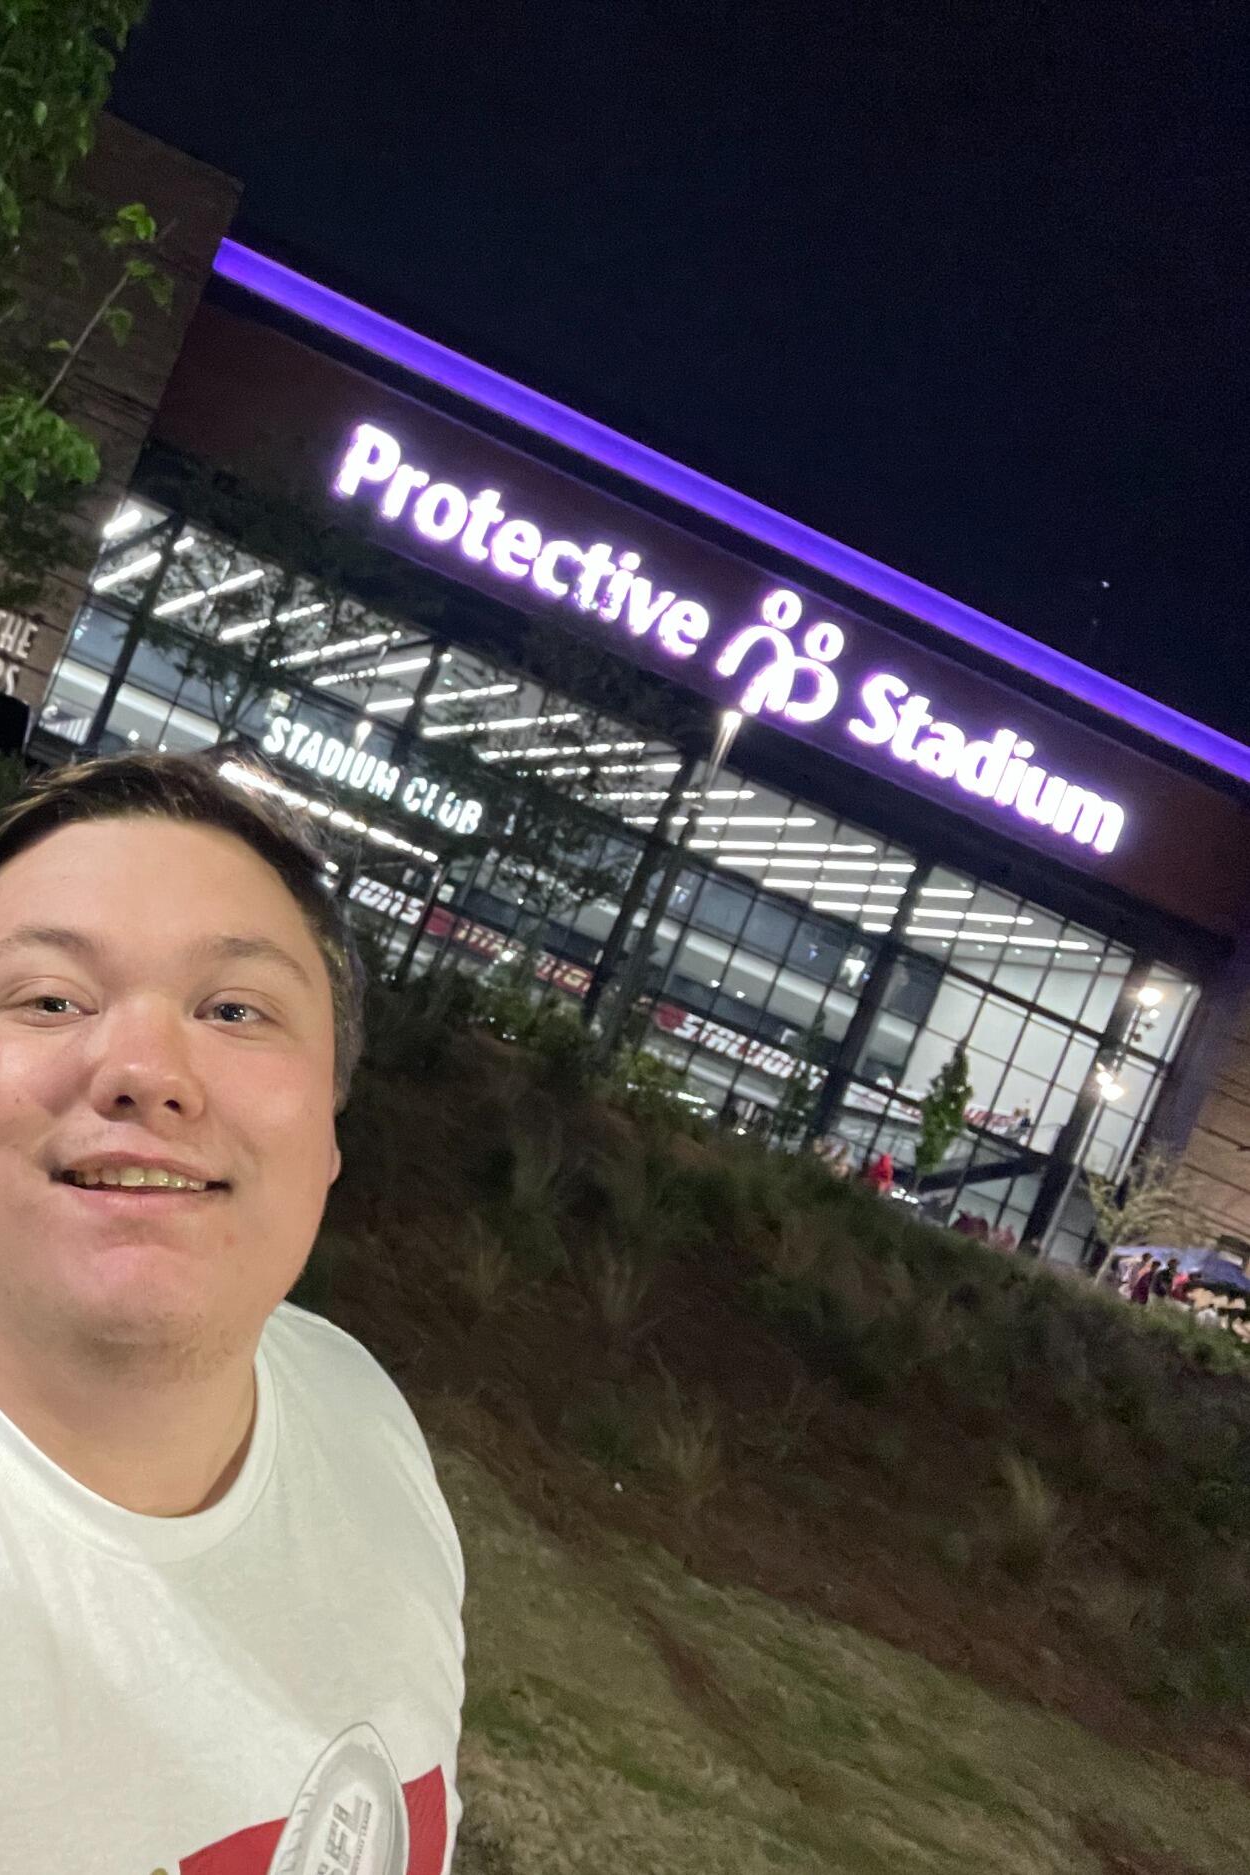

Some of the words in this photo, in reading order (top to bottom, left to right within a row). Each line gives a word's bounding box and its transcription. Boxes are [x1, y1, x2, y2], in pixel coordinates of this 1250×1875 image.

[263, 716, 401, 801] STADIUM
[403, 776, 483, 834] CLUB
[335, 424, 710, 657] Protective
[848, 671, 1125, 855] Stadium
